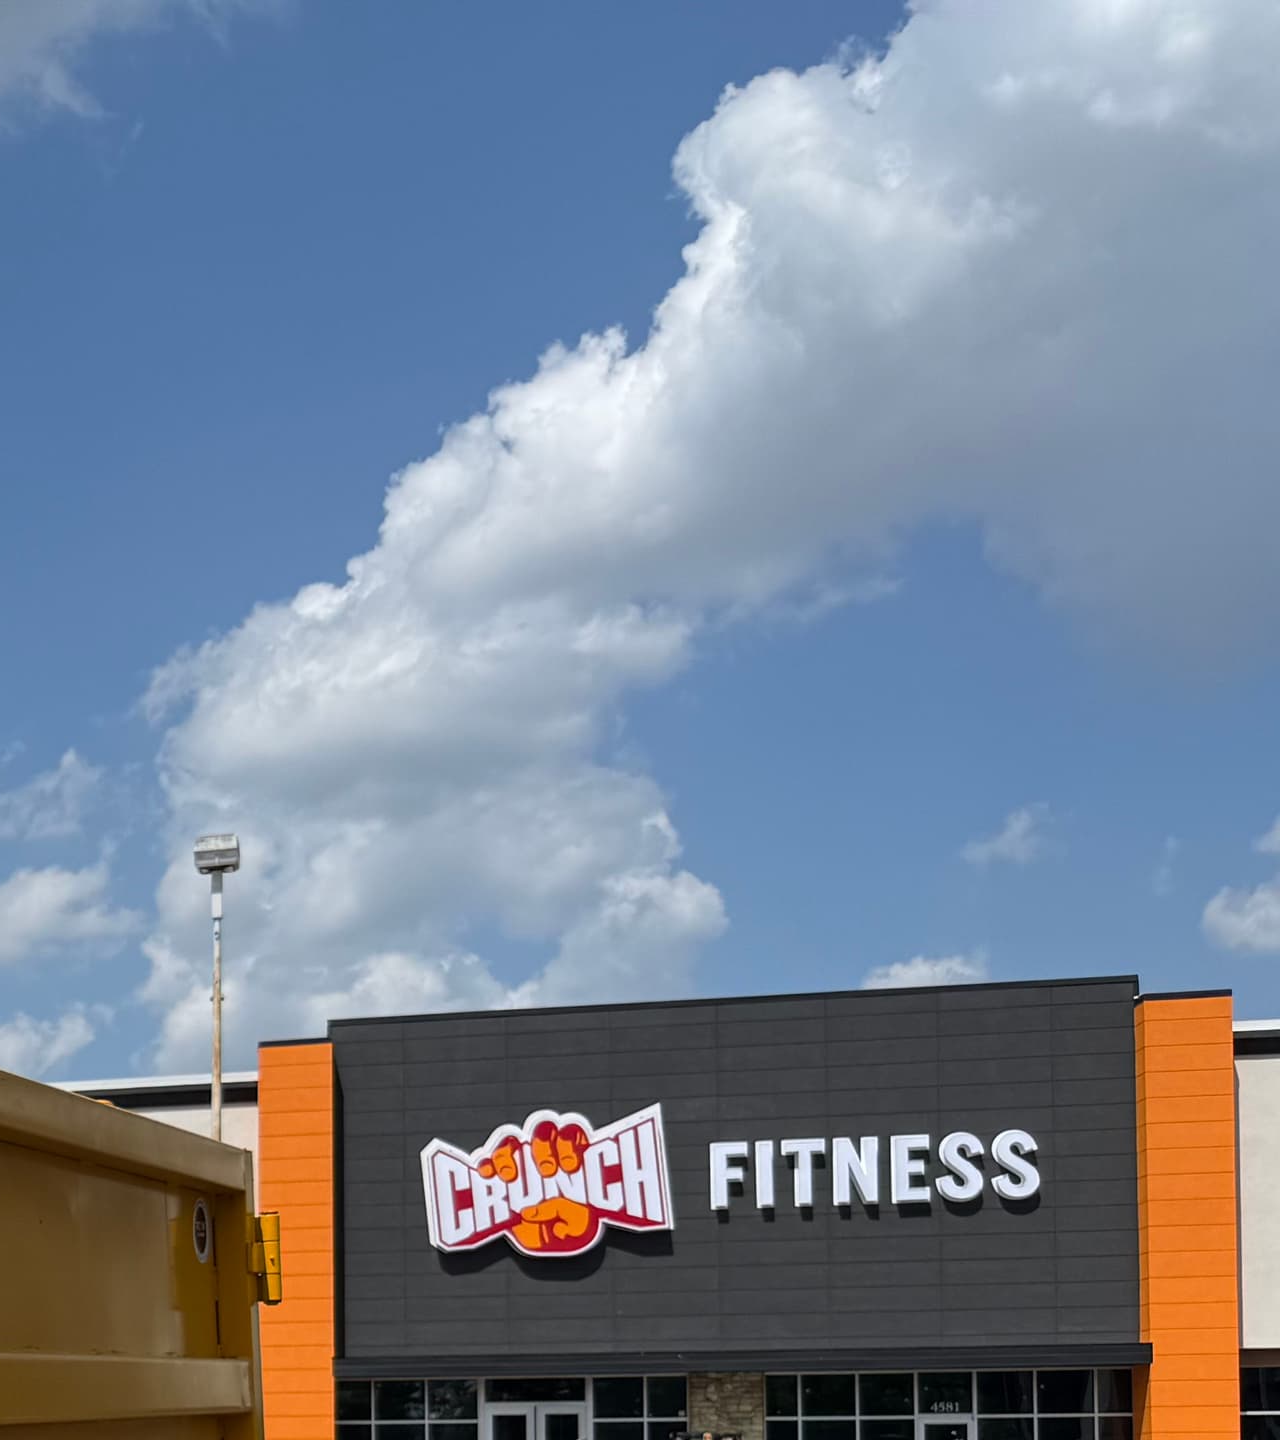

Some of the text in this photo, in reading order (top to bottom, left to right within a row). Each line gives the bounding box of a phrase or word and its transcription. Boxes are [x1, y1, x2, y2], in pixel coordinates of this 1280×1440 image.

[433, 1118, 1042, 1247] CRUNCH FITNESS
[930, 1401, 960, 1412] 4581
